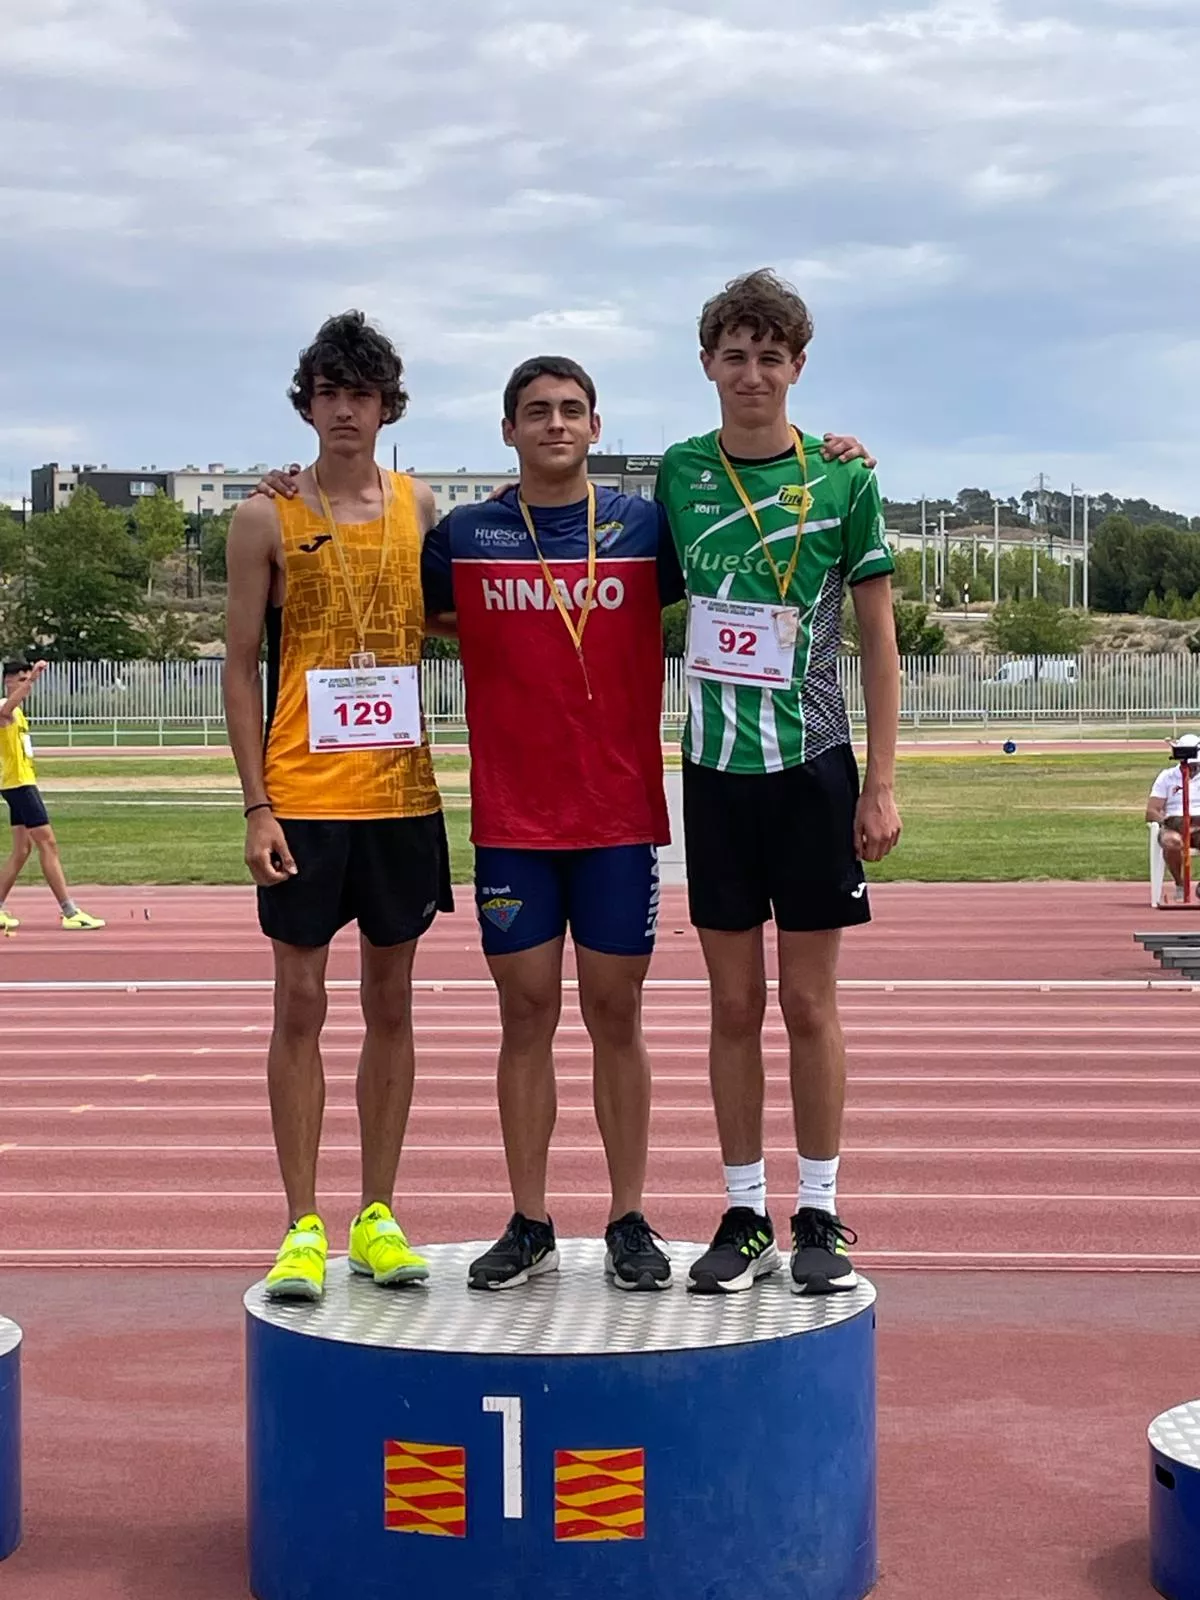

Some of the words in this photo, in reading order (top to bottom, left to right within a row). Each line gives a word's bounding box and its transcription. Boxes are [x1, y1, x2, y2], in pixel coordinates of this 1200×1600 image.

[481, 576, 625, 611] HINACO
[718, 628, 757, 656] 92
[333, 700, 393, 727] 129
[482, 1396, 522, 1518] 1
